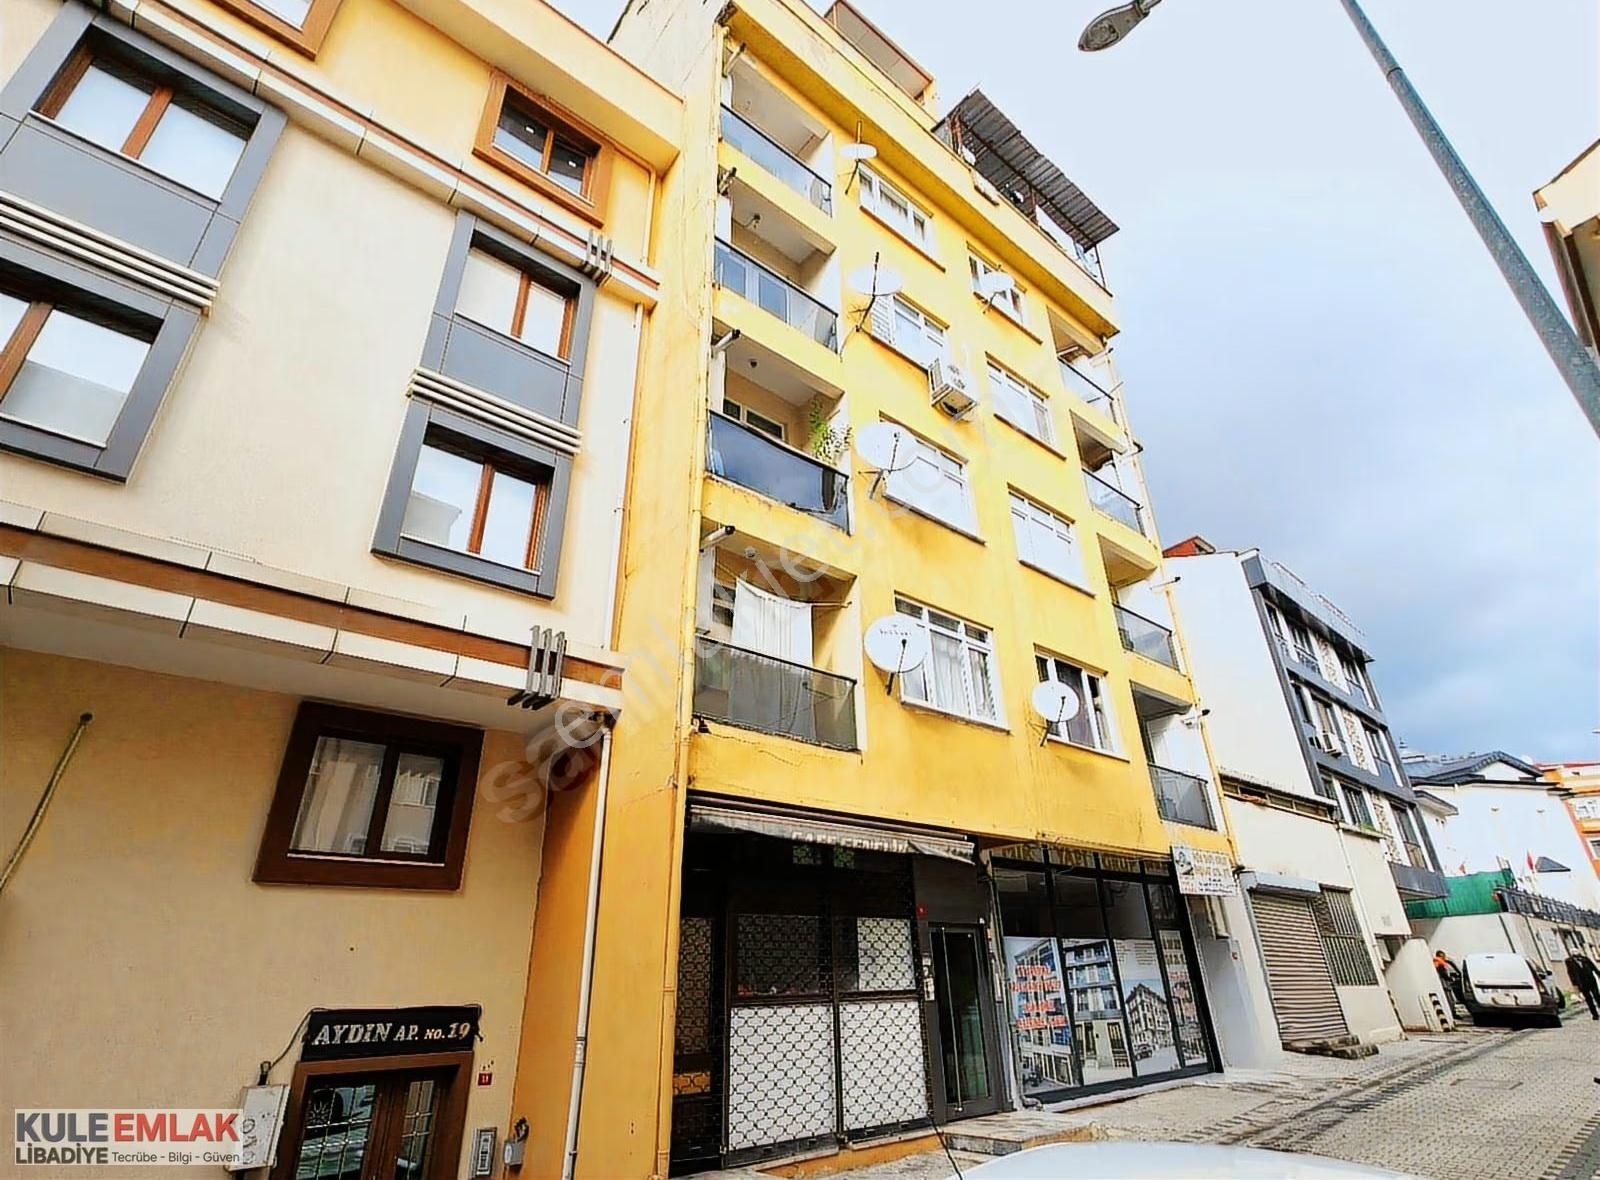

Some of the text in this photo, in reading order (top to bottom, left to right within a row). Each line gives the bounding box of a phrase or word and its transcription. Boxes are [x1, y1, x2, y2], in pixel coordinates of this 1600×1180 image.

[312, 1022, 392, 1046] AYDIN
[393, 1024, 419, 1041] AP.
[447, 1022, 471, 1040] 19
